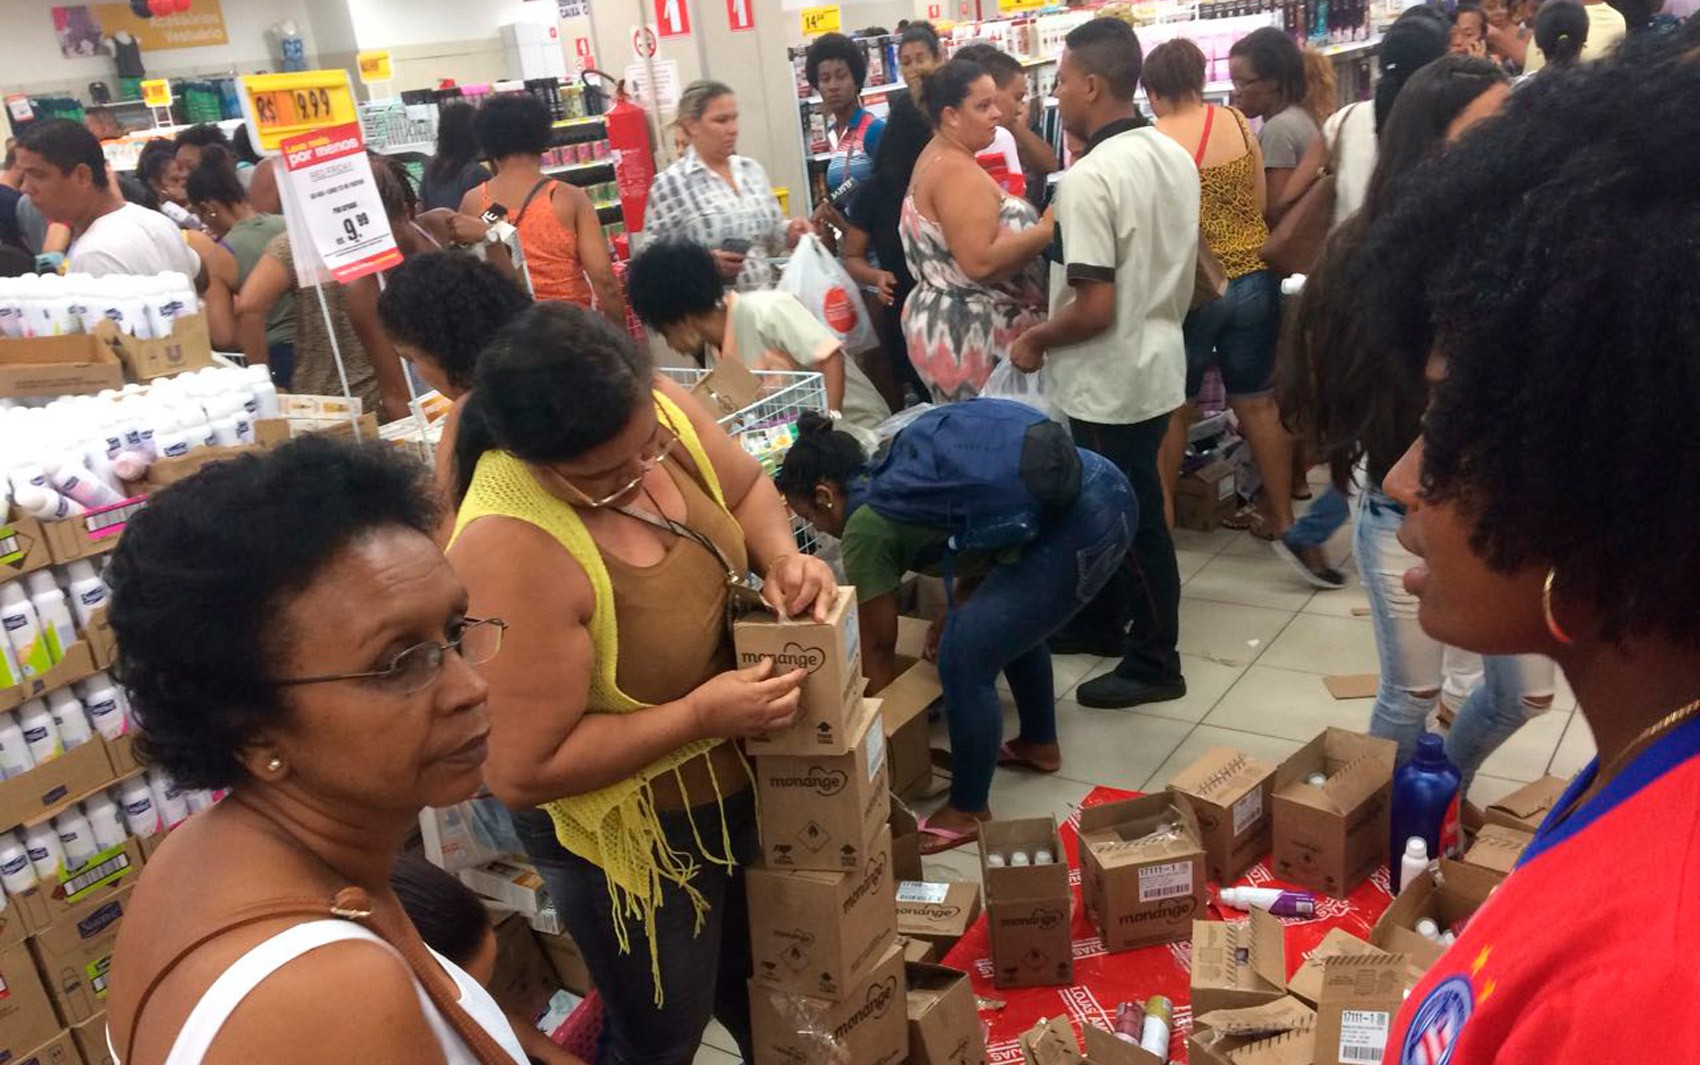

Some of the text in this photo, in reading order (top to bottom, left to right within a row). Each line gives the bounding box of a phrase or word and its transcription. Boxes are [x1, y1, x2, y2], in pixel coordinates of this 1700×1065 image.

[255, 95, 277, 123] R$
[288, 137, 359, 168] por menos
[769, 776, 840, 792] monange
[842, 862, 883, 915] monange
[1119, 903, 1190, 926] monange
[834, 986, 893, 1042] monange
[1069, 986, 1097, 1015] LOJAS
[1343, 1011, 1375, 1023] 17111-1
